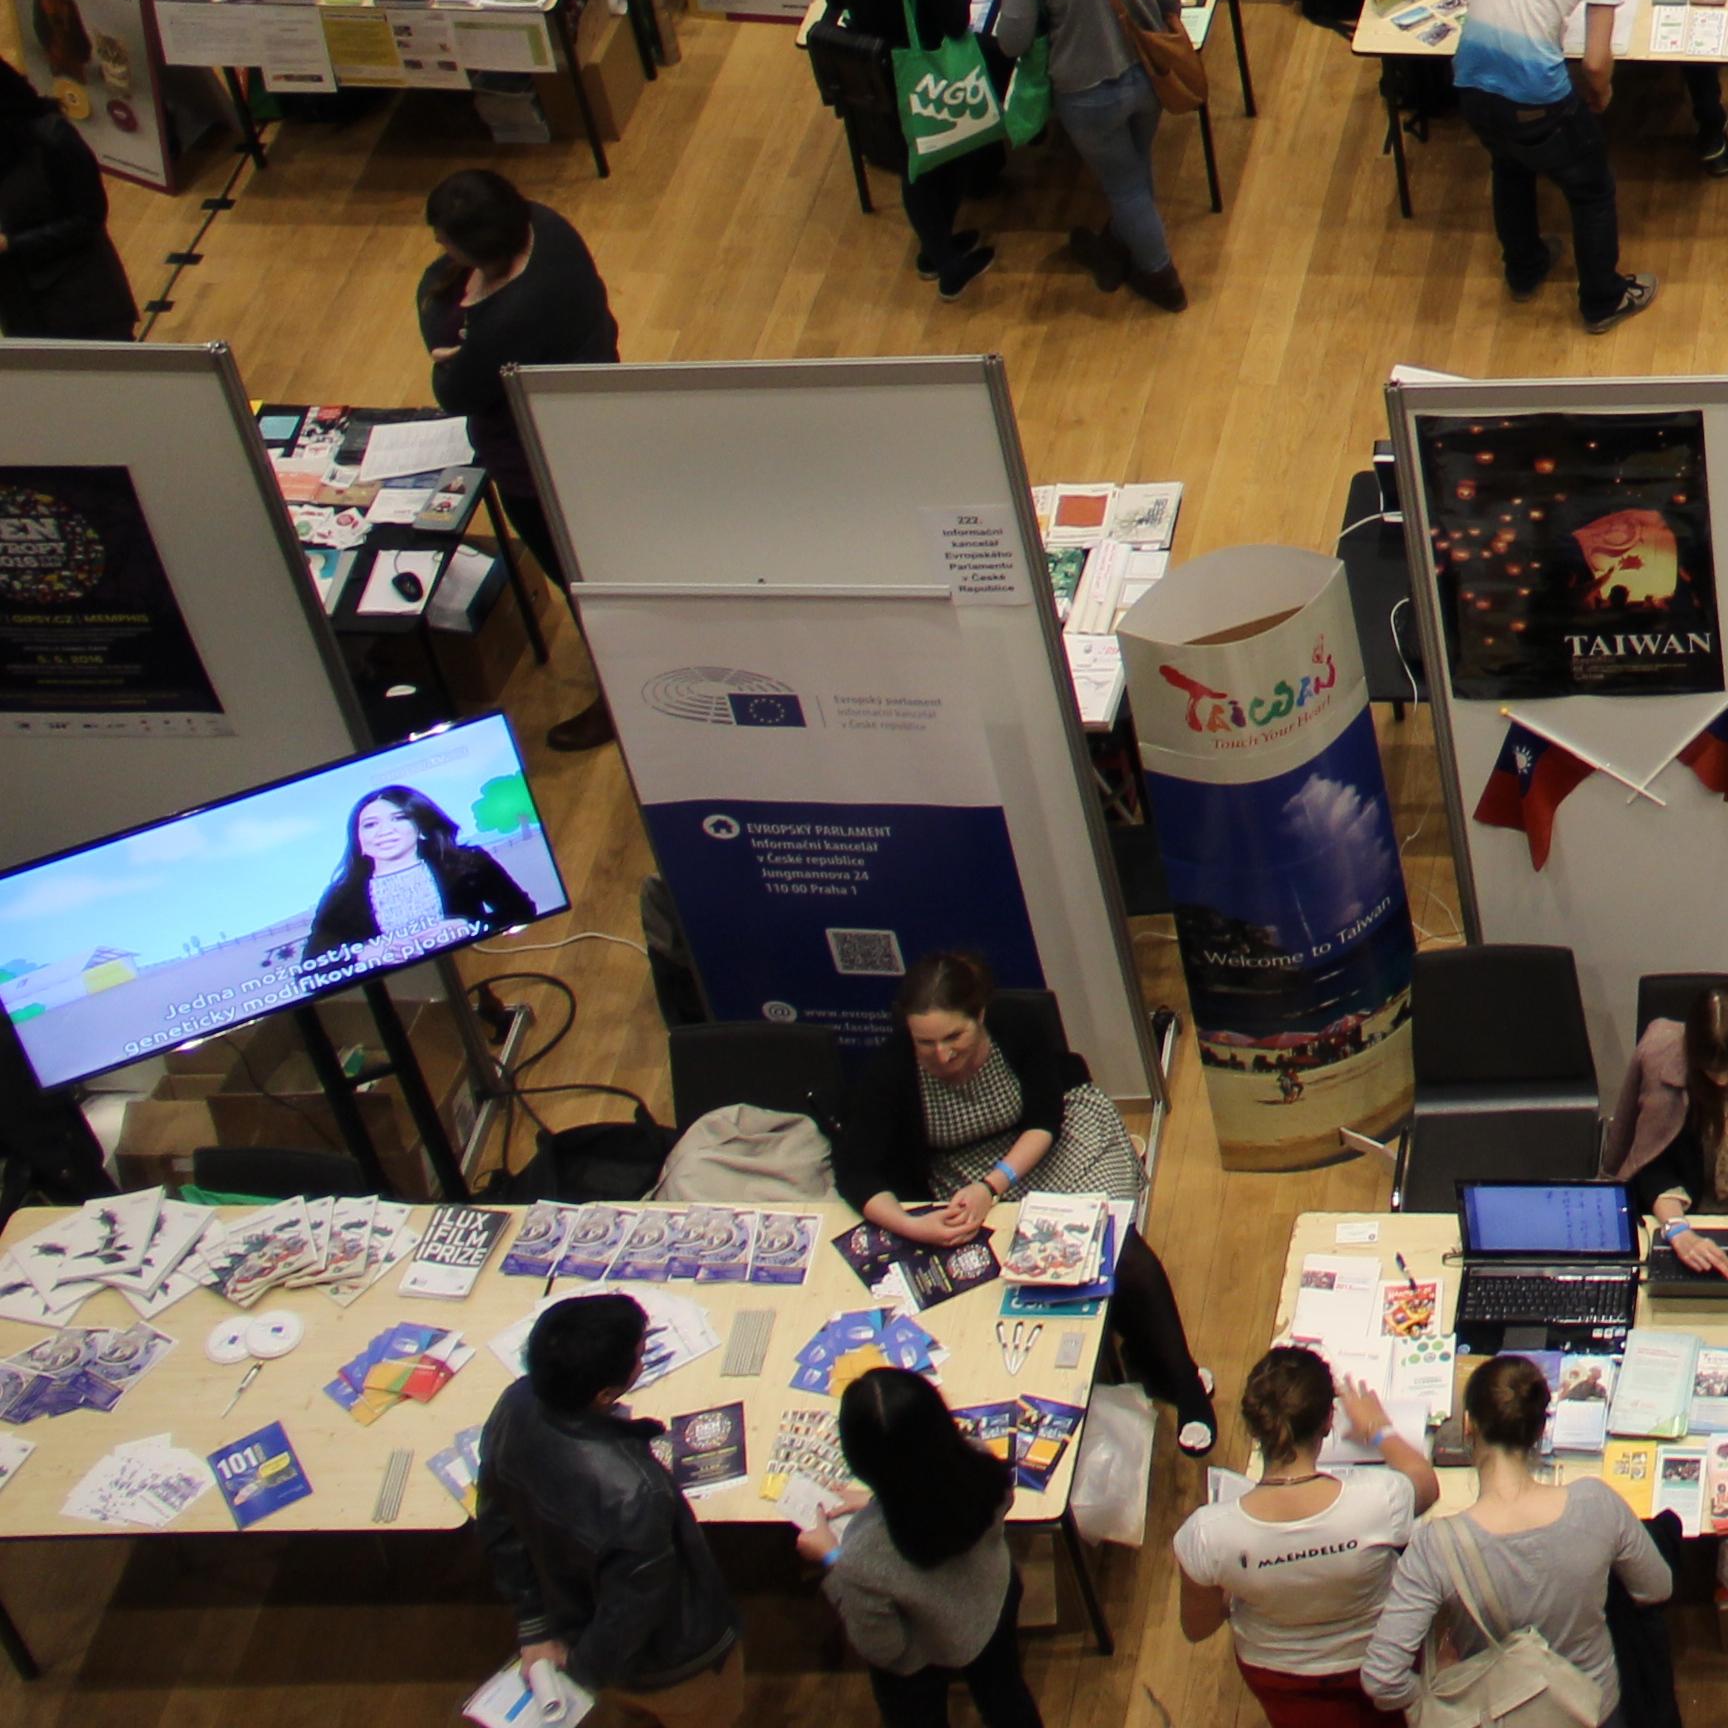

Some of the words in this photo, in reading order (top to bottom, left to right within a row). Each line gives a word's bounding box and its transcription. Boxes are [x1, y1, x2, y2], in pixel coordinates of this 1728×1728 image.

[1564, 632, 1712, 658] TAIWAN
[747, 821, 811, 837] EVROPSKÝ
[814, 823, 892, 838] PARLAMENT
[752, 836, 820, 852] Informační
[823, 839, 879, 852] kancelář
[762, 868, 848, 882] Jungmannova
[853, 869, 868, 880] 24
[1205, 943, 1305, 969] Welcome
[1311, 939, 1331, 956] to
[1336, 896, 1392, 943] Taiwan
[164, 988, 234, 1020] Jedna
[241, 948, 344, 992] možnost
[341, 943, 363, 968] je
[368, 916, 436, 952] využít
[124, 1008, 237, 1055] geneticky
[243, 952, 397, 1012] modifikované
[401, 919, 490, 963] plodiny,
[446, 1208, 491, 1230] LUX
[433, 1225, 488, 1248] FILM
[429, 1243, 487, 1268] PRIZE
[217, 1448, 260, 1478] 101
[1258, 1539, 1359, 1570] MAENDELEO
